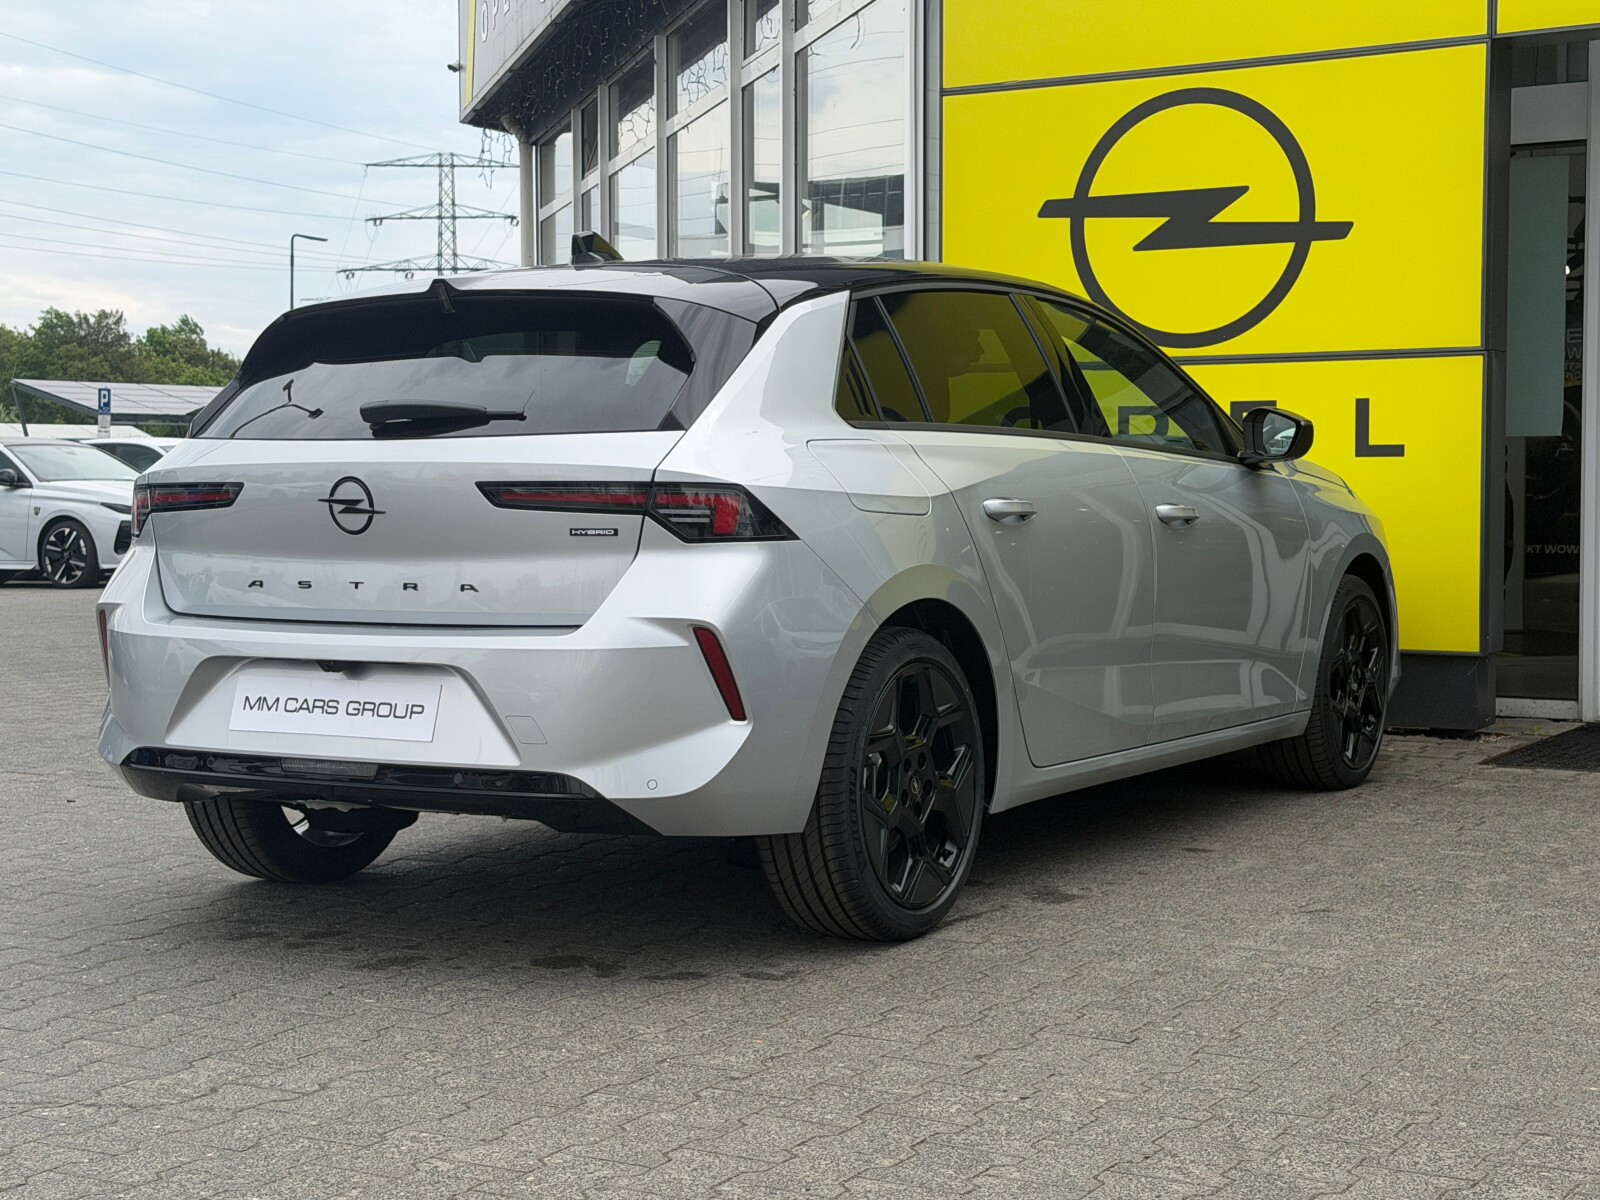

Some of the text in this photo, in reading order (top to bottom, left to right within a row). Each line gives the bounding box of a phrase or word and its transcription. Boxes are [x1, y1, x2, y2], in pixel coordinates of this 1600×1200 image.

[100, 390, 109, 407] P
[1544, 544, 1580, 554] WOW
[247, 579, 480, 593] ASTRA
[242, 695, 425, 720] MM CARS GROUP
